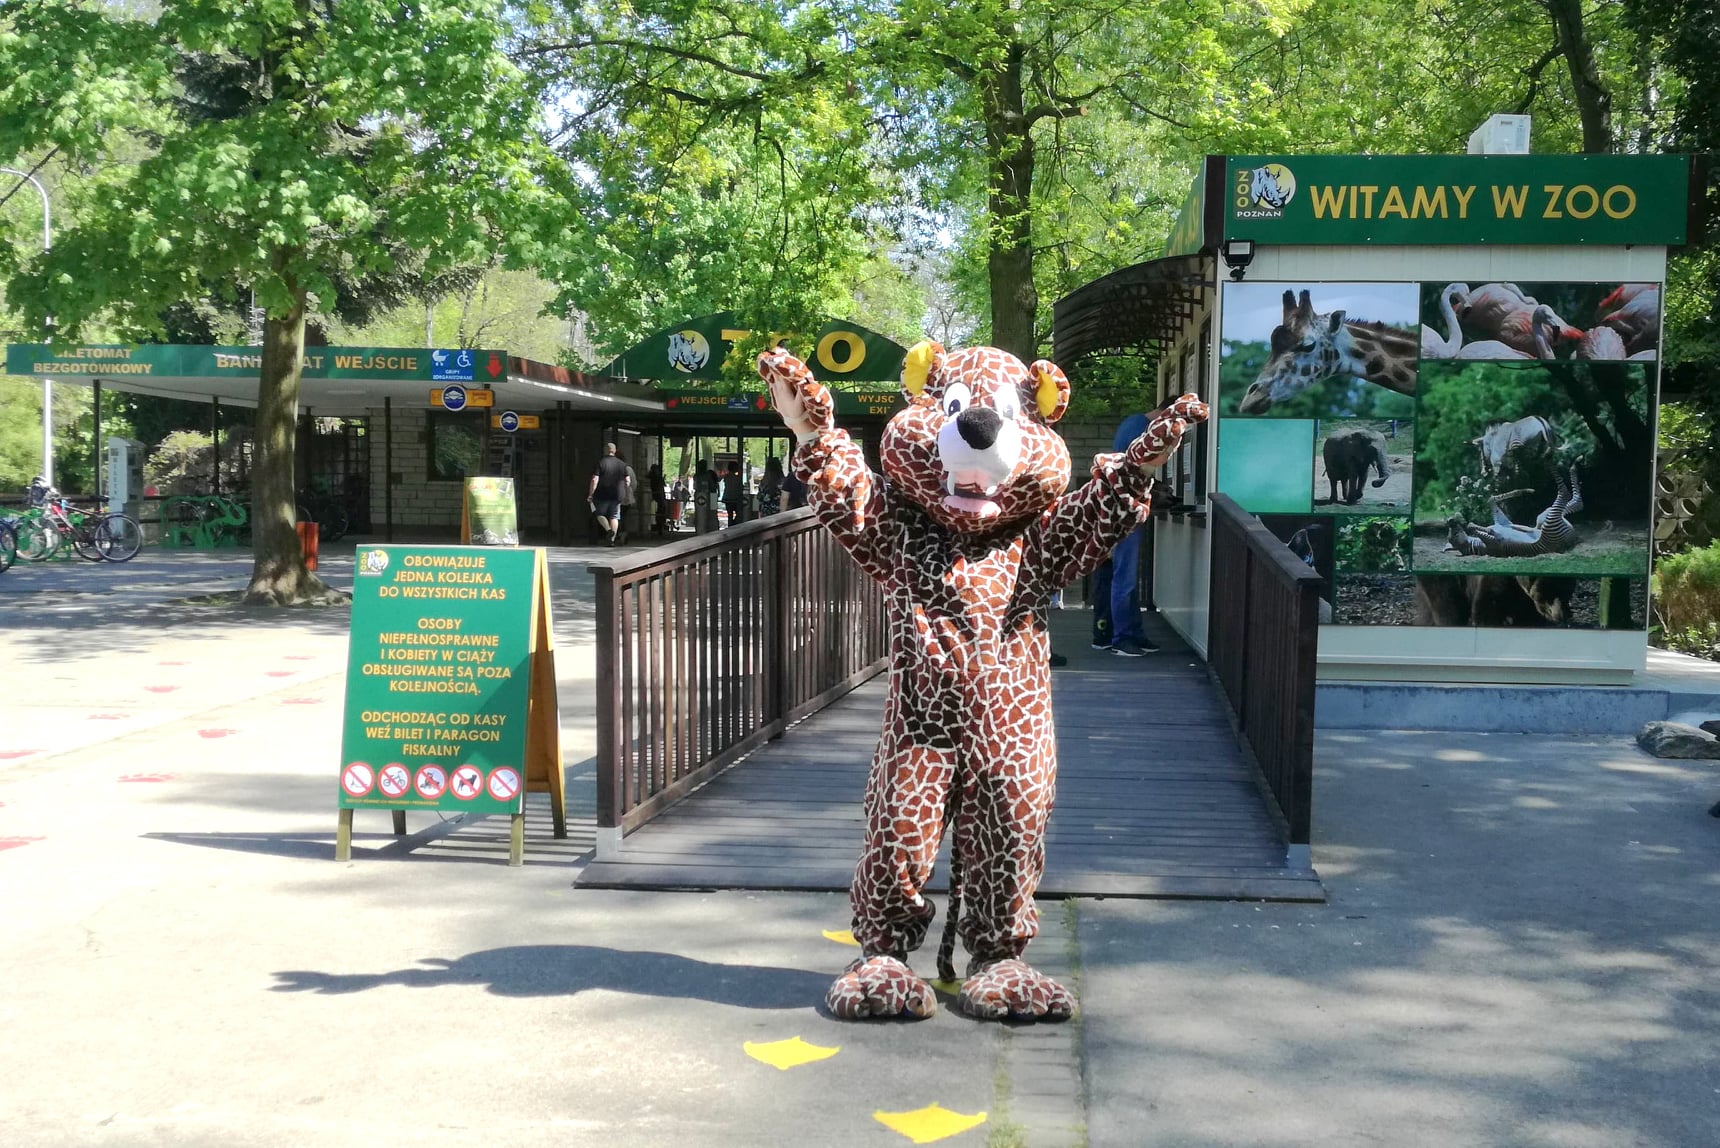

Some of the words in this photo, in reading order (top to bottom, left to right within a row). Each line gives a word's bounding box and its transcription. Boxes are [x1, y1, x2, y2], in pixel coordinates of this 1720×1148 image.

[1236, 170, 1250, 208] ZOO
[1309, 184, 1476, 219] WITAMY
[1491, 185, 1530, 219] W
[1543, 184, 1637, 220] ZOO
[54, 348, 132, 359] ILETOMAT
[869, 405, 891, 414] EXI
[403, 555, 486, 570] OBOWIĄZUJE
[393, 571, 434, 583] JEDNA
[438, 571, 493, 584] KOLEJKA
[379, 586, 399, 598] DO
[402, 586, 478, 599] WSZYSTKICH
[480, 588, 506, 600] KAS
[417, 618, 462, 630] OSOBY
[379, 633, 499, 646] NIEPEŁNOSPRAWNE
[380, 649, 385, 660] I
[388, 649, 437, 661] KOBIETY
[441, 650, 454, 661] W
[457, 649, 495, 665] CIĄŻY
[362, 664, 454, 678] OBSŁUGIWANE
[457, 666, 474, 680] SĄ
[477, 667, 512, 679] POZA
[389, 679, 482, 697] KOLEJNOŚCIĄ.
[361, 711, 446, 727] ODCHODZĄC
[449, 713, 470, 726] OD
[473, 714, 507, 726] KASY
[365, 724, 391, 739] WEŹ
[394, 727, 424, 739] BILET
[426, 728, 430, 740] I
[434, 729, 500, 742] PARAGON
[402, 743, 461, 756] FISKALNY
